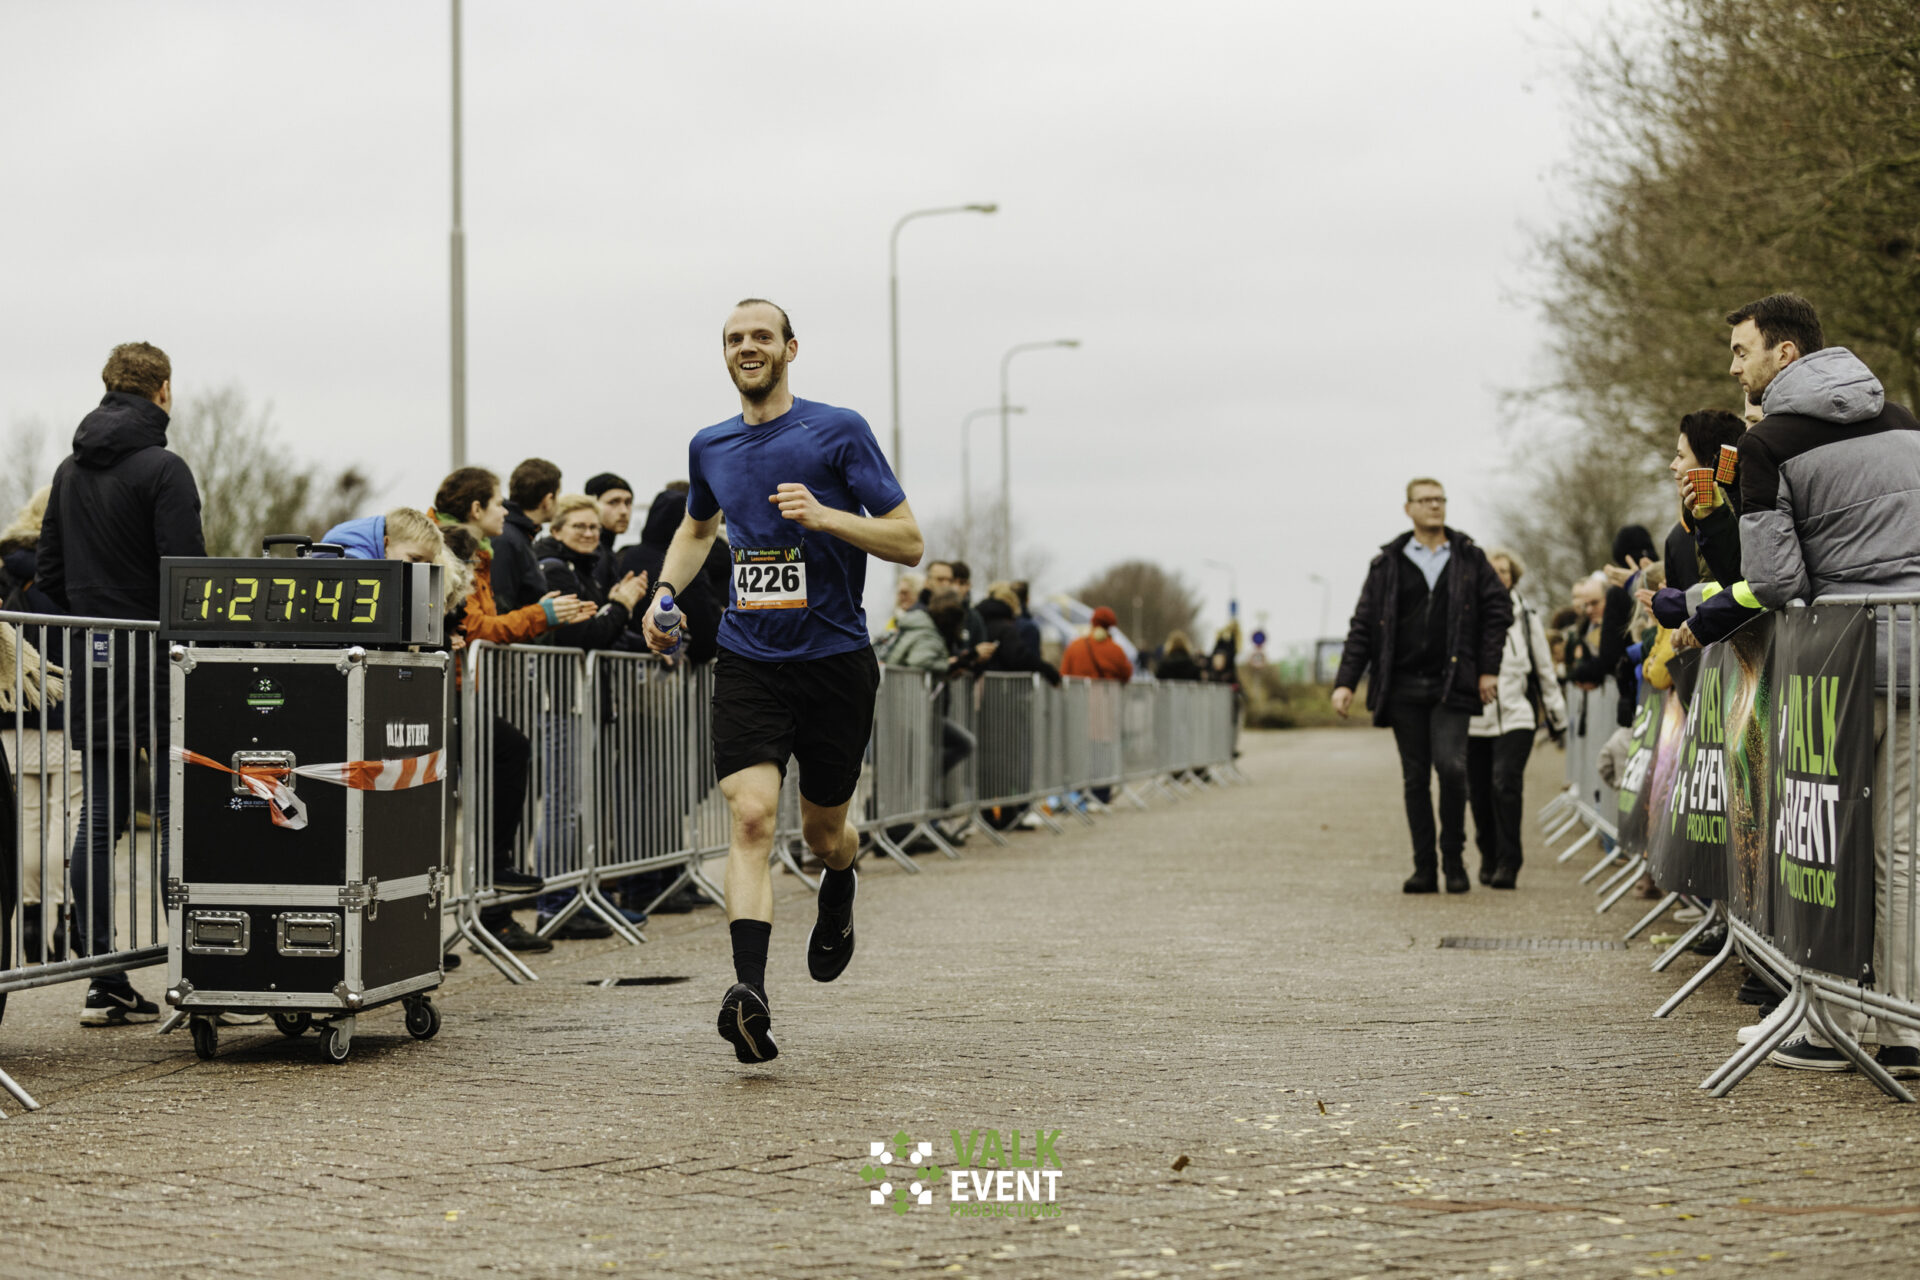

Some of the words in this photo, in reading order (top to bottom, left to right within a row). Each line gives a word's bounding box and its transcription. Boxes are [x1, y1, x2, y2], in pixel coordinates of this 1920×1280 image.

[201, 578, 381, 623] 1:27:43
[737, 565, 800, 593] 4226
[1788, 674, 1840, 777] VALK
[1785, 777, 1840, 865] EVENT
